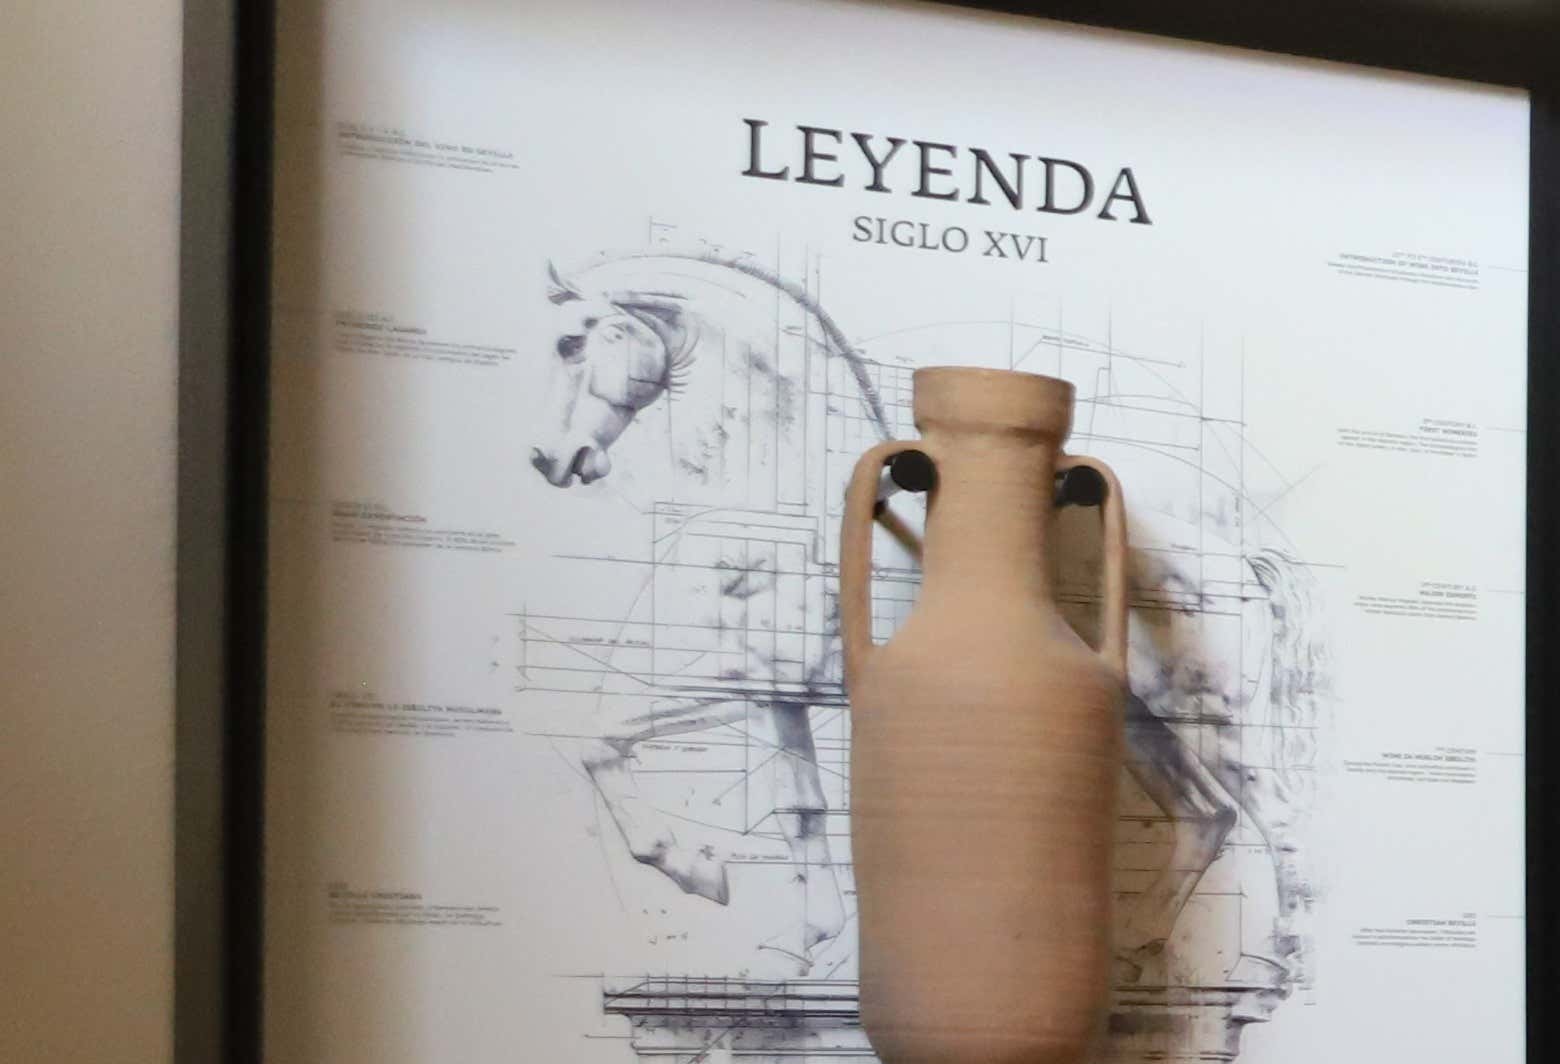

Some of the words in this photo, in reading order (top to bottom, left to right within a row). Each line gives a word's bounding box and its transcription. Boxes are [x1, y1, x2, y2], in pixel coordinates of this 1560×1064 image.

[741, 117, 1153, 226] LEYENDA
[852, 215, 969, 253] SIGLO
[982, 229, 1050, 263] XVI
